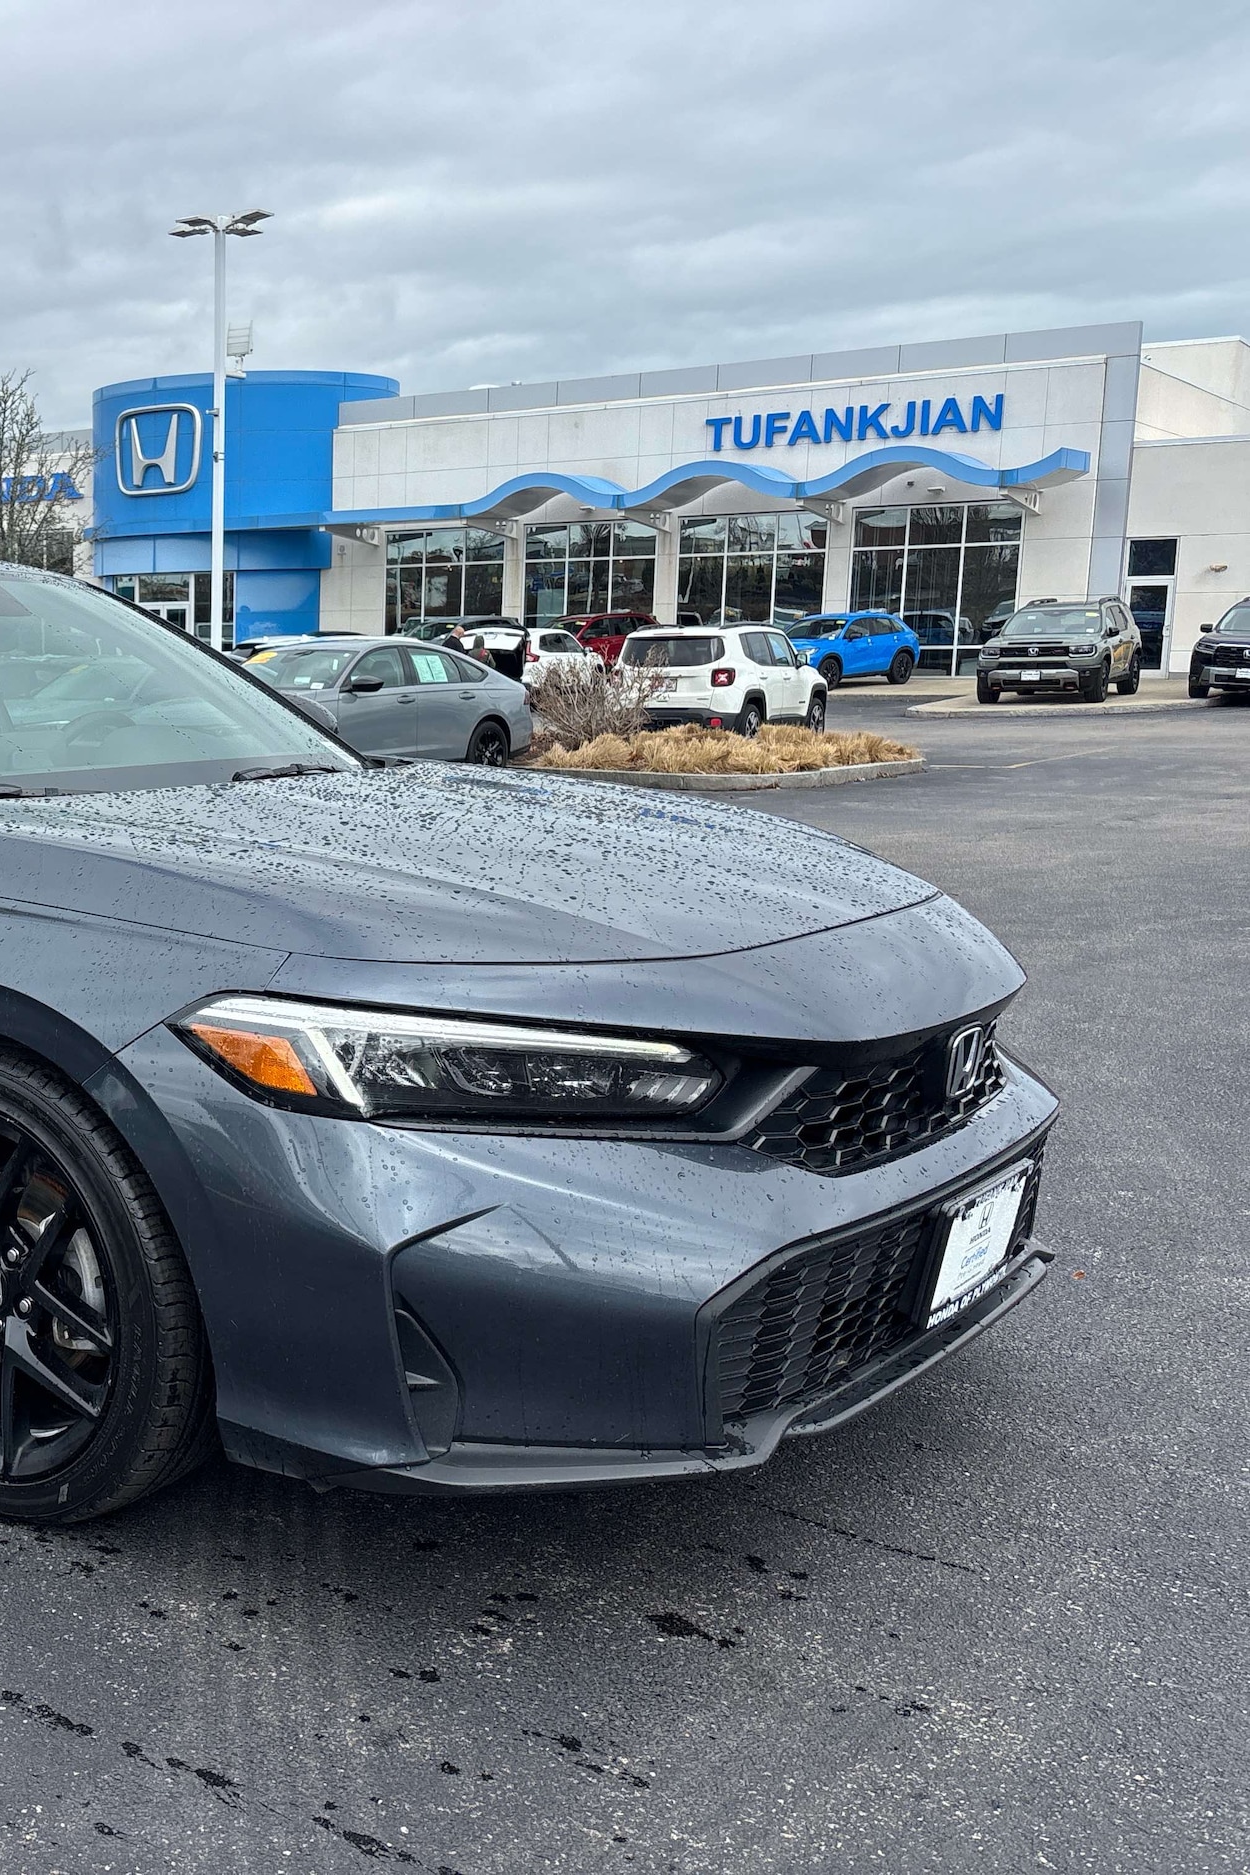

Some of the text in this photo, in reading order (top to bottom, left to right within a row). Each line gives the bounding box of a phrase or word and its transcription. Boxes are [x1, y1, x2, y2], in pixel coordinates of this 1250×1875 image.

[706, 393, 1004, 451] TUFANKJIAN
[926, 1300, 960, 1330] HONDA
[959, 1290, 974, 1310] OF
